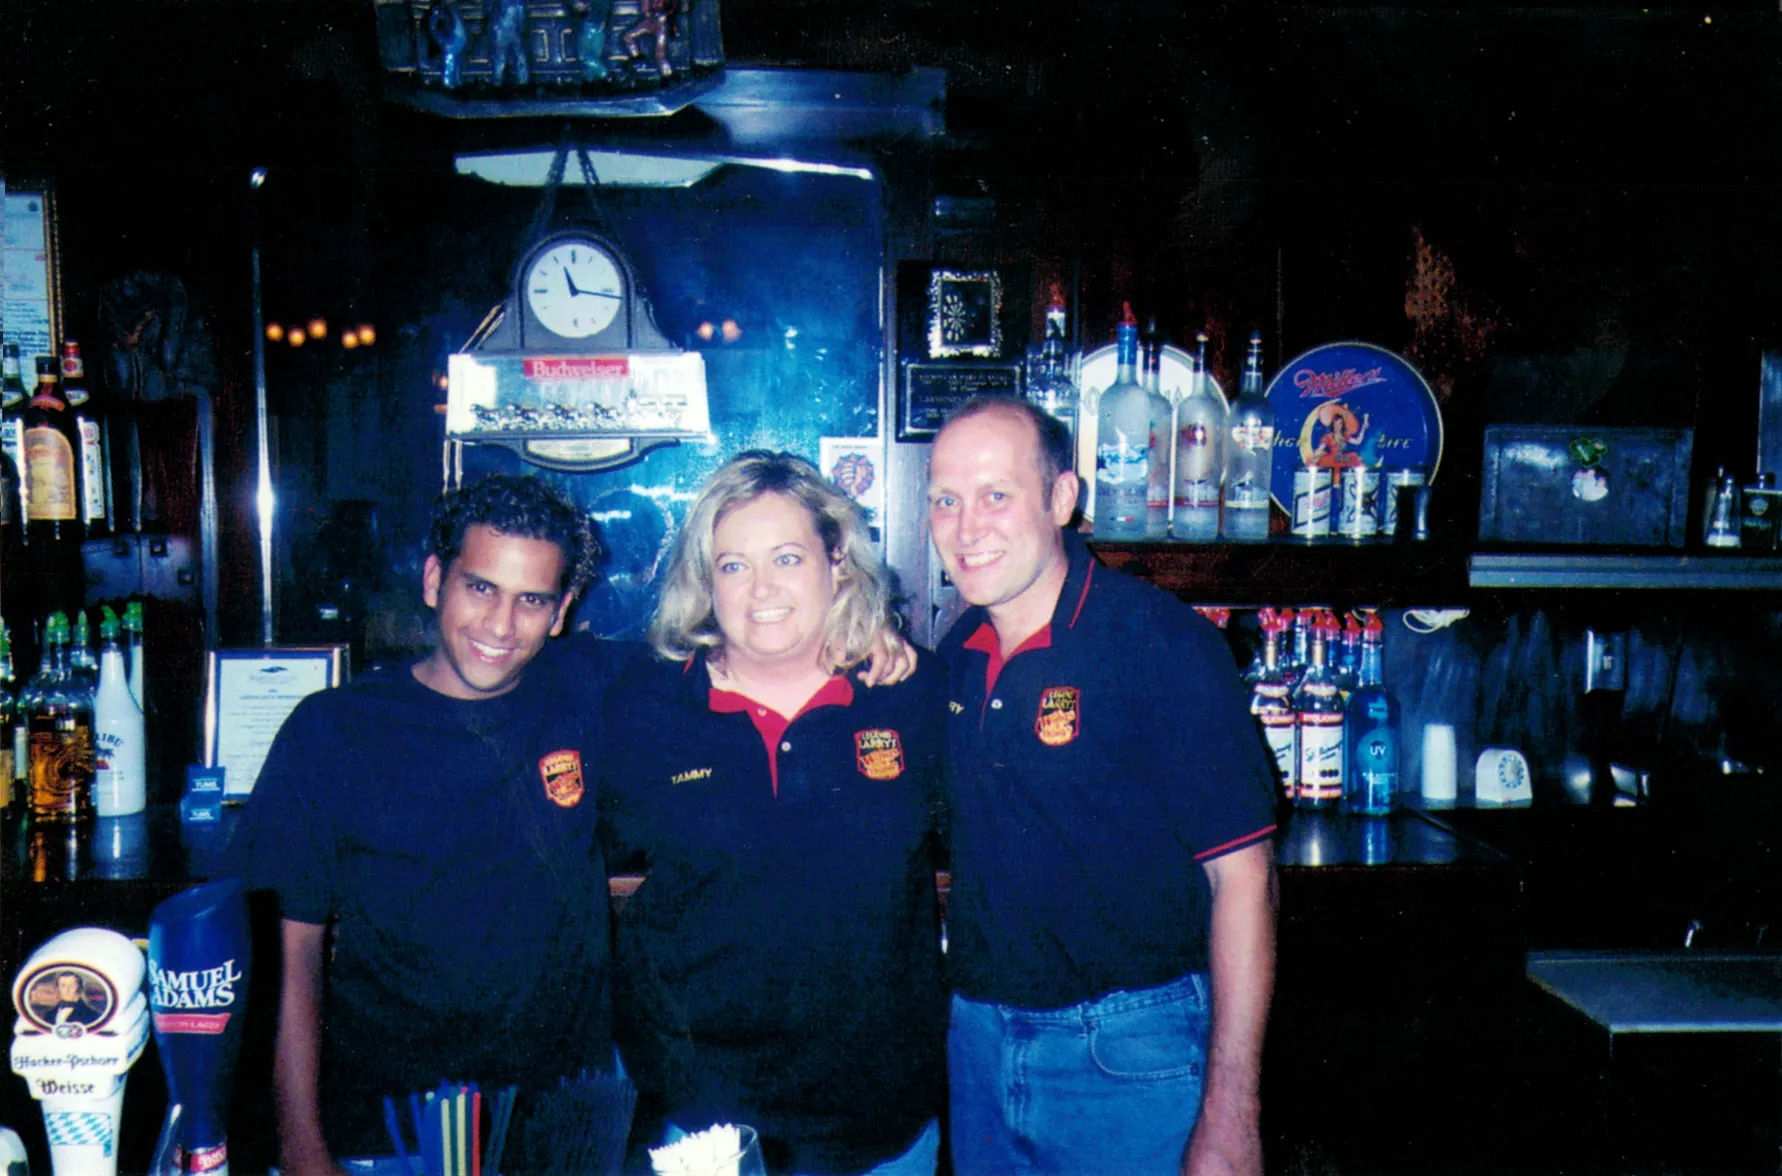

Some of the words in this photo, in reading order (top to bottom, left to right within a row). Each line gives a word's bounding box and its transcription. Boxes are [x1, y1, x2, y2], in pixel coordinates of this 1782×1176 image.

[532, 358, 624, 379] Budweiser
[1369, 744, 1386, 756] UV
[671, 767, 713, 785] TAMMY
[148, 958, 242, 992] SAMUEL
[150, 982, 235, 1009] ADAMS
[36, 1079, 95, 1095] Weisse
